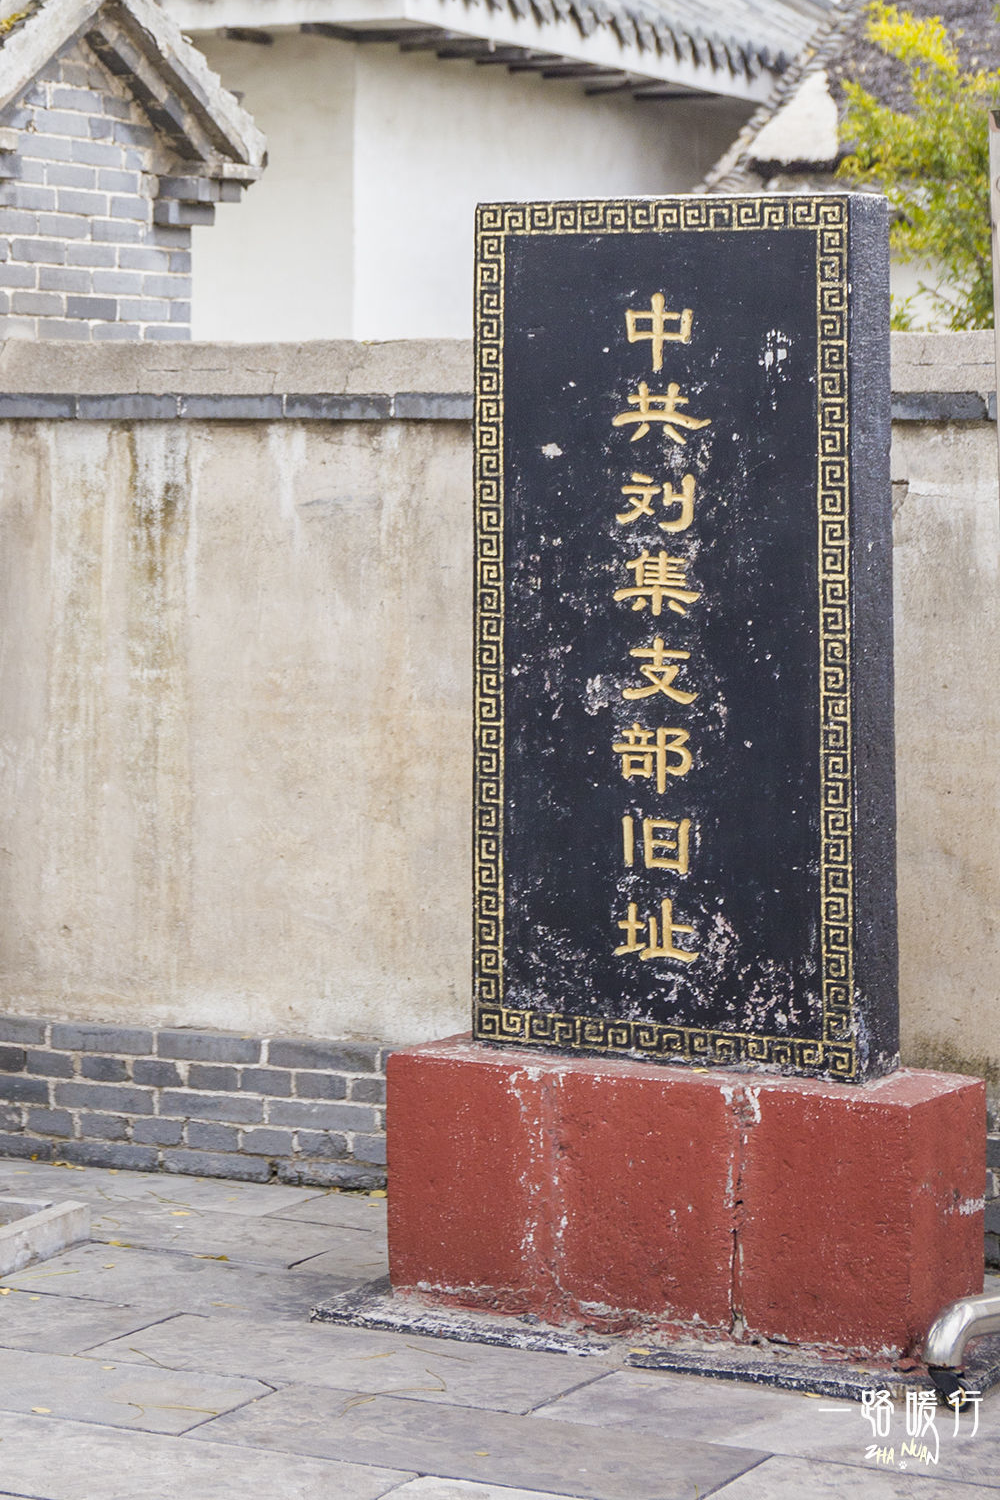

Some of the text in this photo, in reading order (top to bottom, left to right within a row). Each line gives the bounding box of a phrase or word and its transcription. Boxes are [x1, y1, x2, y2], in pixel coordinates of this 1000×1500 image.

[612, 291, 711, 964] 中共刘集支部旧址
